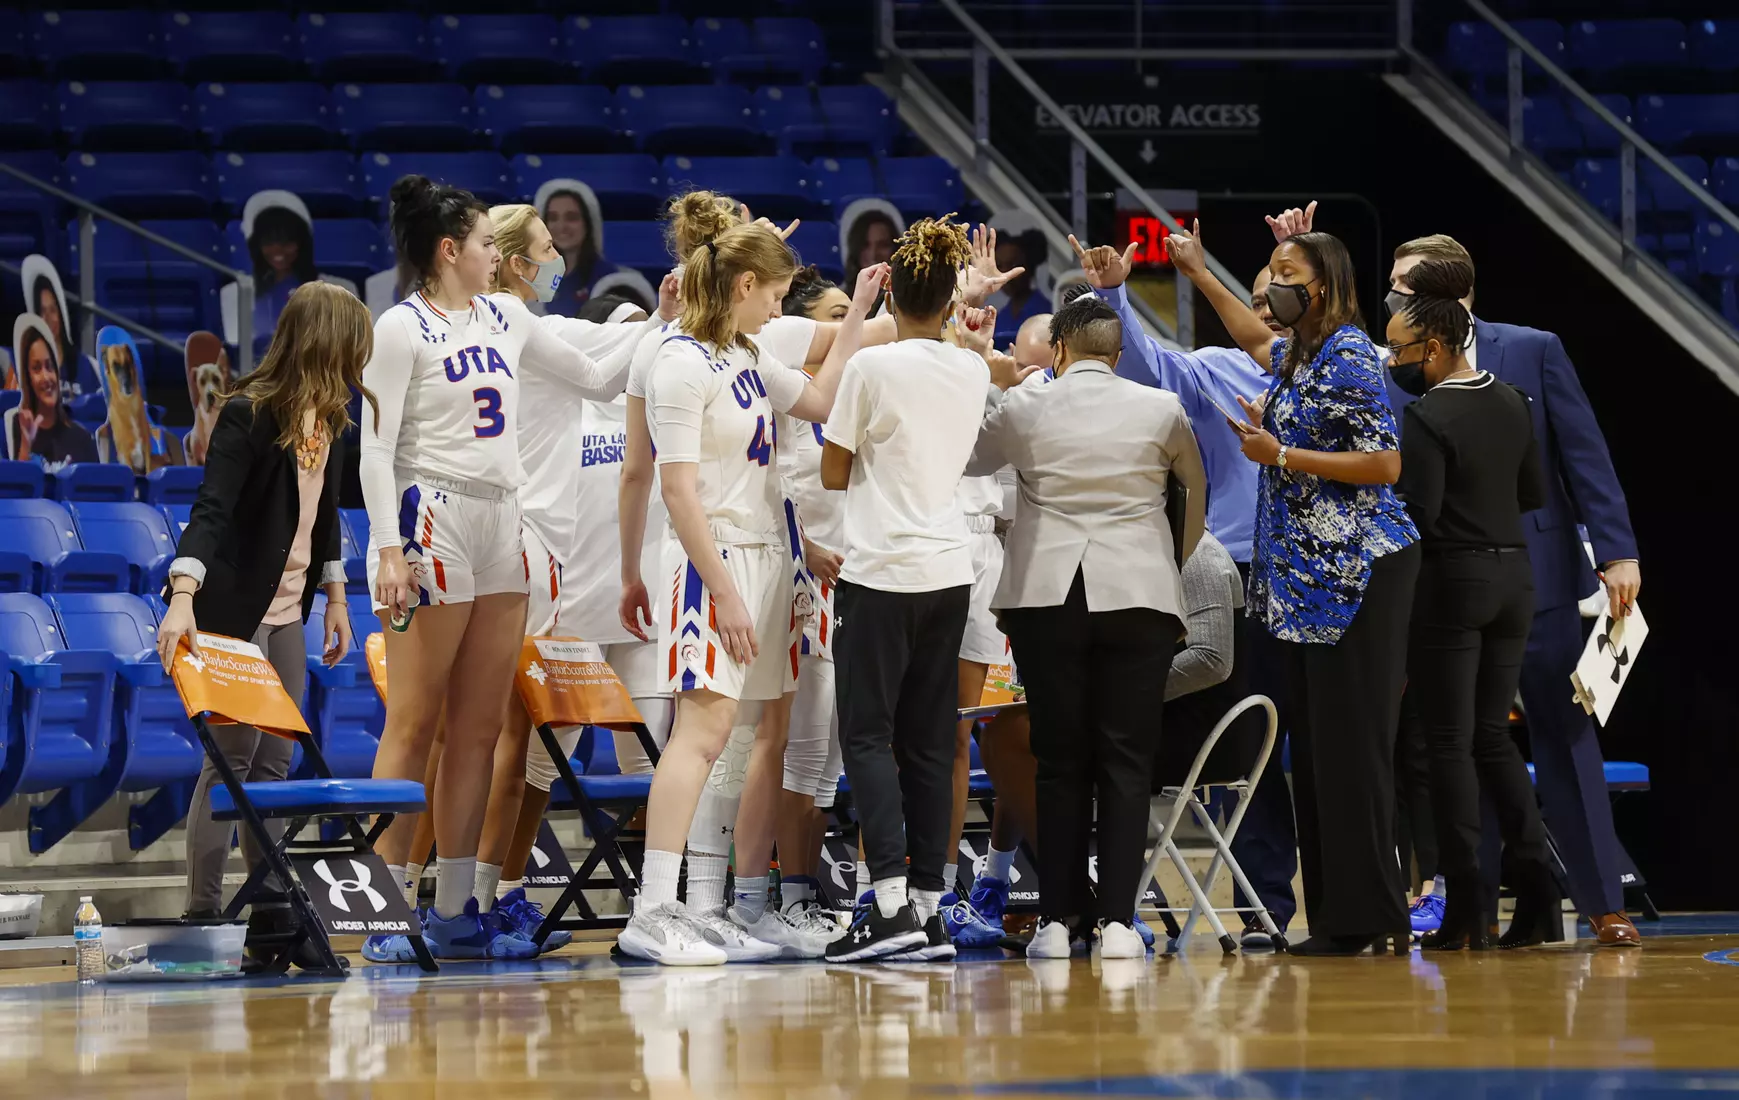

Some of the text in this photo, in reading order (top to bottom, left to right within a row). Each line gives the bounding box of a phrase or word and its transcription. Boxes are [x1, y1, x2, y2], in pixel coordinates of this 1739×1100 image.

[1169, 104, 1261, 127] ACCESS
[1129, 217, 1184, 262] EXI
[443, 345, 514, 383] UTA
[472, 386, 506, 438] 3
[582, 434, 607, 448] UTA
[531, 875, 571, 884] ARMOUR
[331, 920, 411, 931] UNDER ARMOUR
